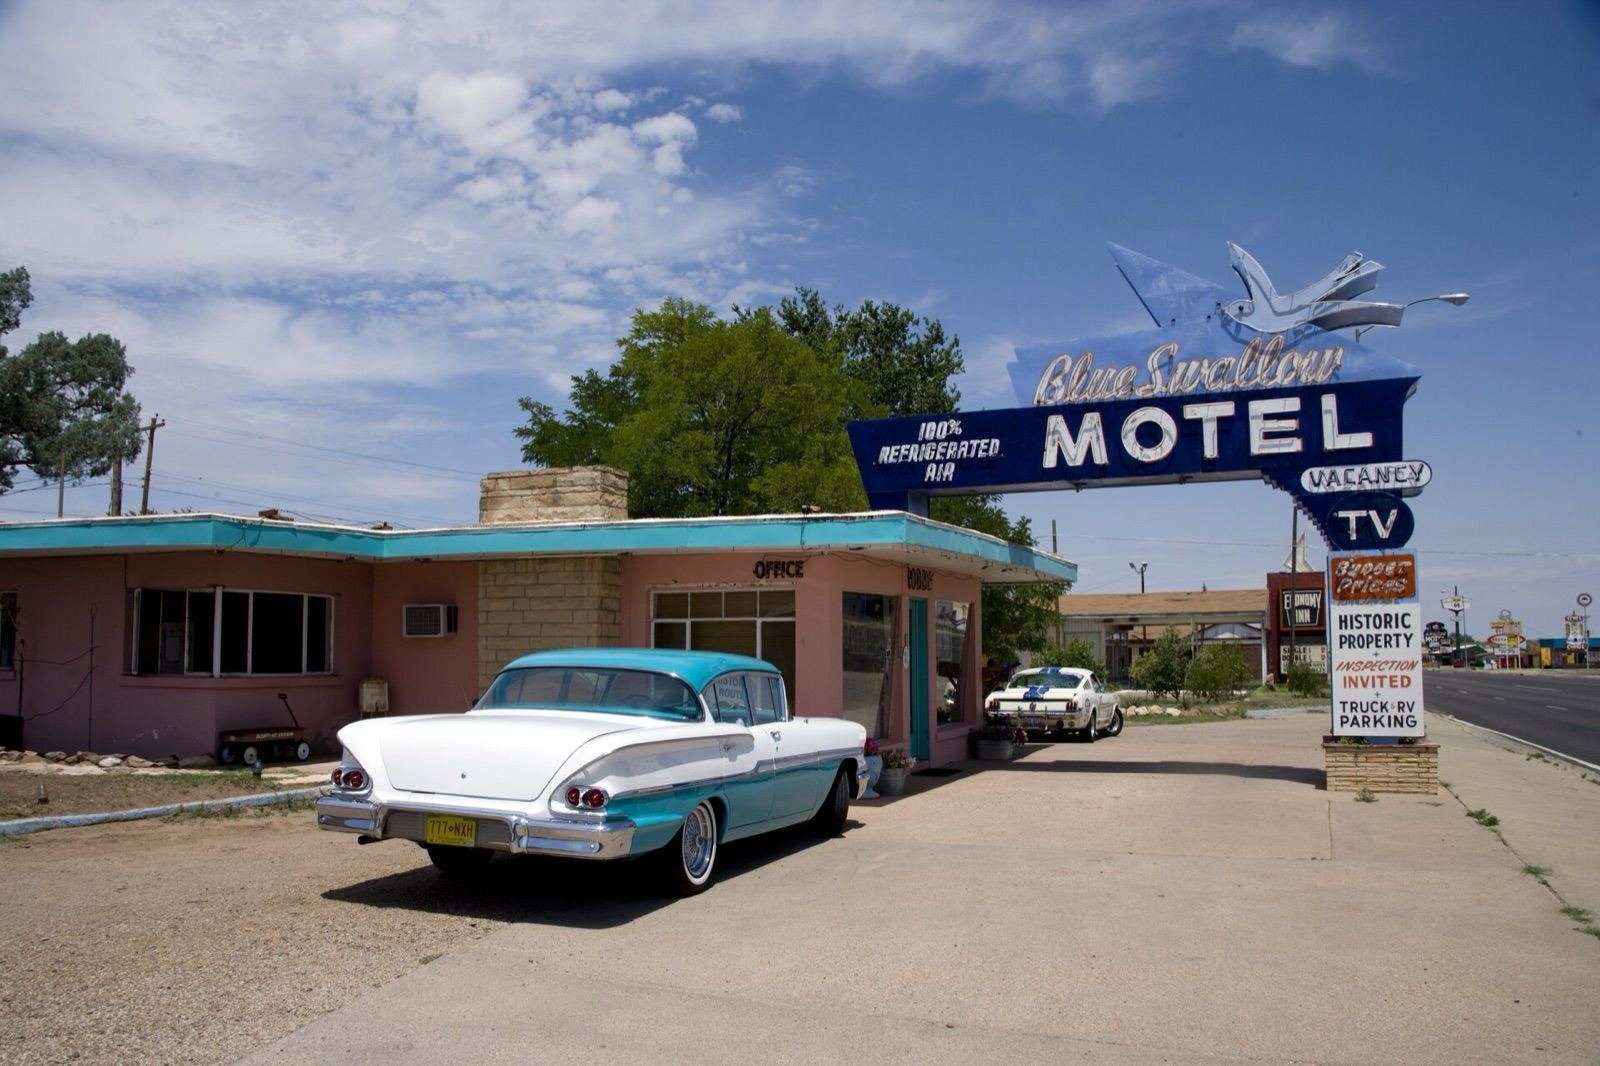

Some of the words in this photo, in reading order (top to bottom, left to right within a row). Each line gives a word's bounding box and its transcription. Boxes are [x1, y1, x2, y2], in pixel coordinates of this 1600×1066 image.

[1033, 352, 1137, 405] Blue
[1136, 335, 1343, 397] Swallow
[917, 419, 962, 441] 100%
[1042, 394, 1373, 468] MOTEL
[878, 439, 1001, 464] REFRIGERATED
[924, 462, 956, 482] AIR
[1309, 464, 1424, 488] VACANCY
[1337, 509, 1398, 540] TV
[753, 560, 804, 579] OFFICE
[1284, 592, 1321, 610] EONOMY
[1295, 608, 1311, 623] INN
[1338, 612, 1412, 631] HISTORIC
[1339, 633, 1414, 650] PROPERTY
[1336, 660, 1419, 671] INSPECTION
[1343, 675, 1412, 689] INVITED
[1339, 701, 1389, 714] TRUCK
[1397, 701, 1416, 714] RV
[1340, 714, 1418, 729] PARKING
